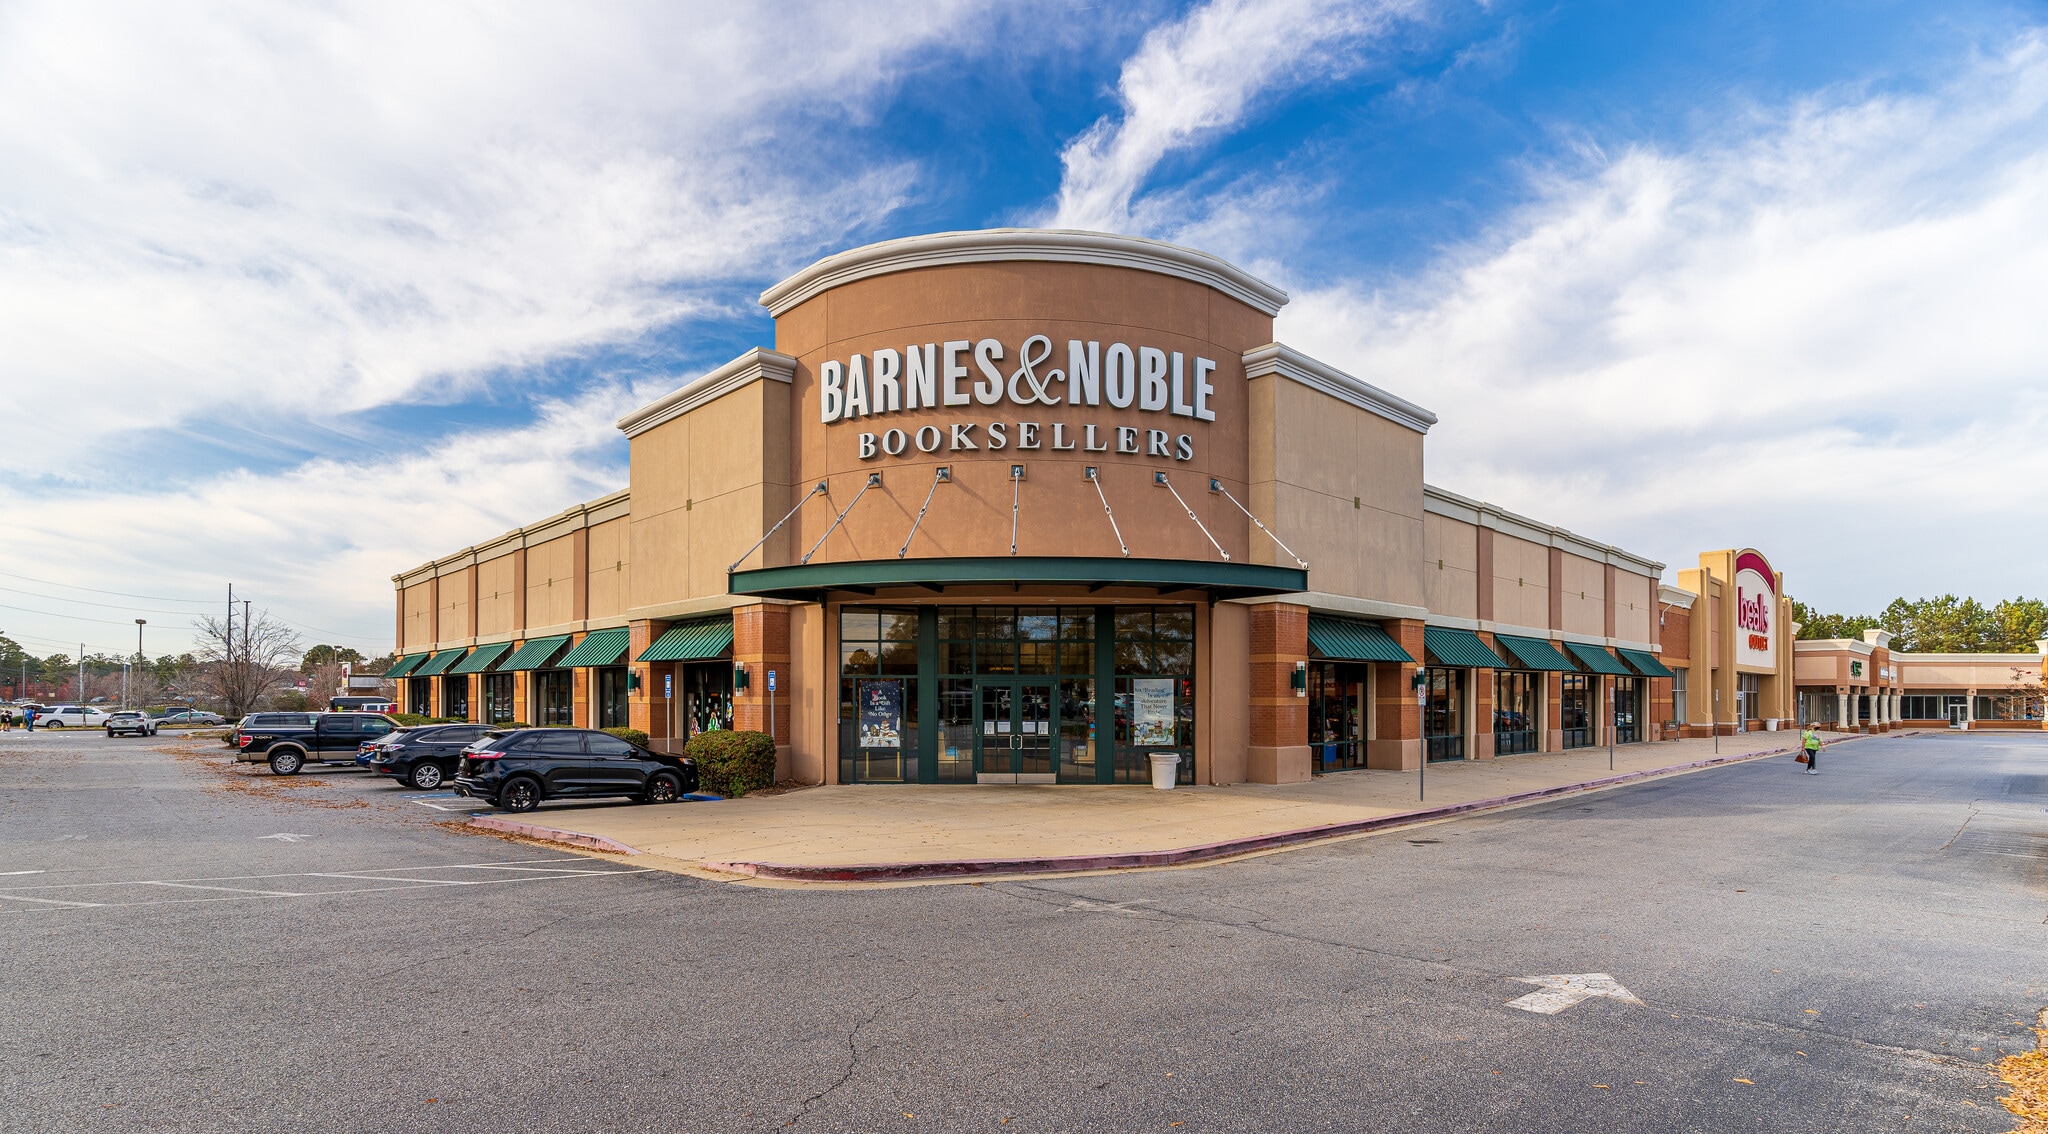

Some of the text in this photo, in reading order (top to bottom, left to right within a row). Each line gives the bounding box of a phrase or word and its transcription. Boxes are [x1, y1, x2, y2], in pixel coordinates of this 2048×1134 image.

[857, 422, 1194, 461] BOOKSELLERS
[1738, 586, 1768, 634] bealls
[1748, 634, 1769, 651] OUTLET
